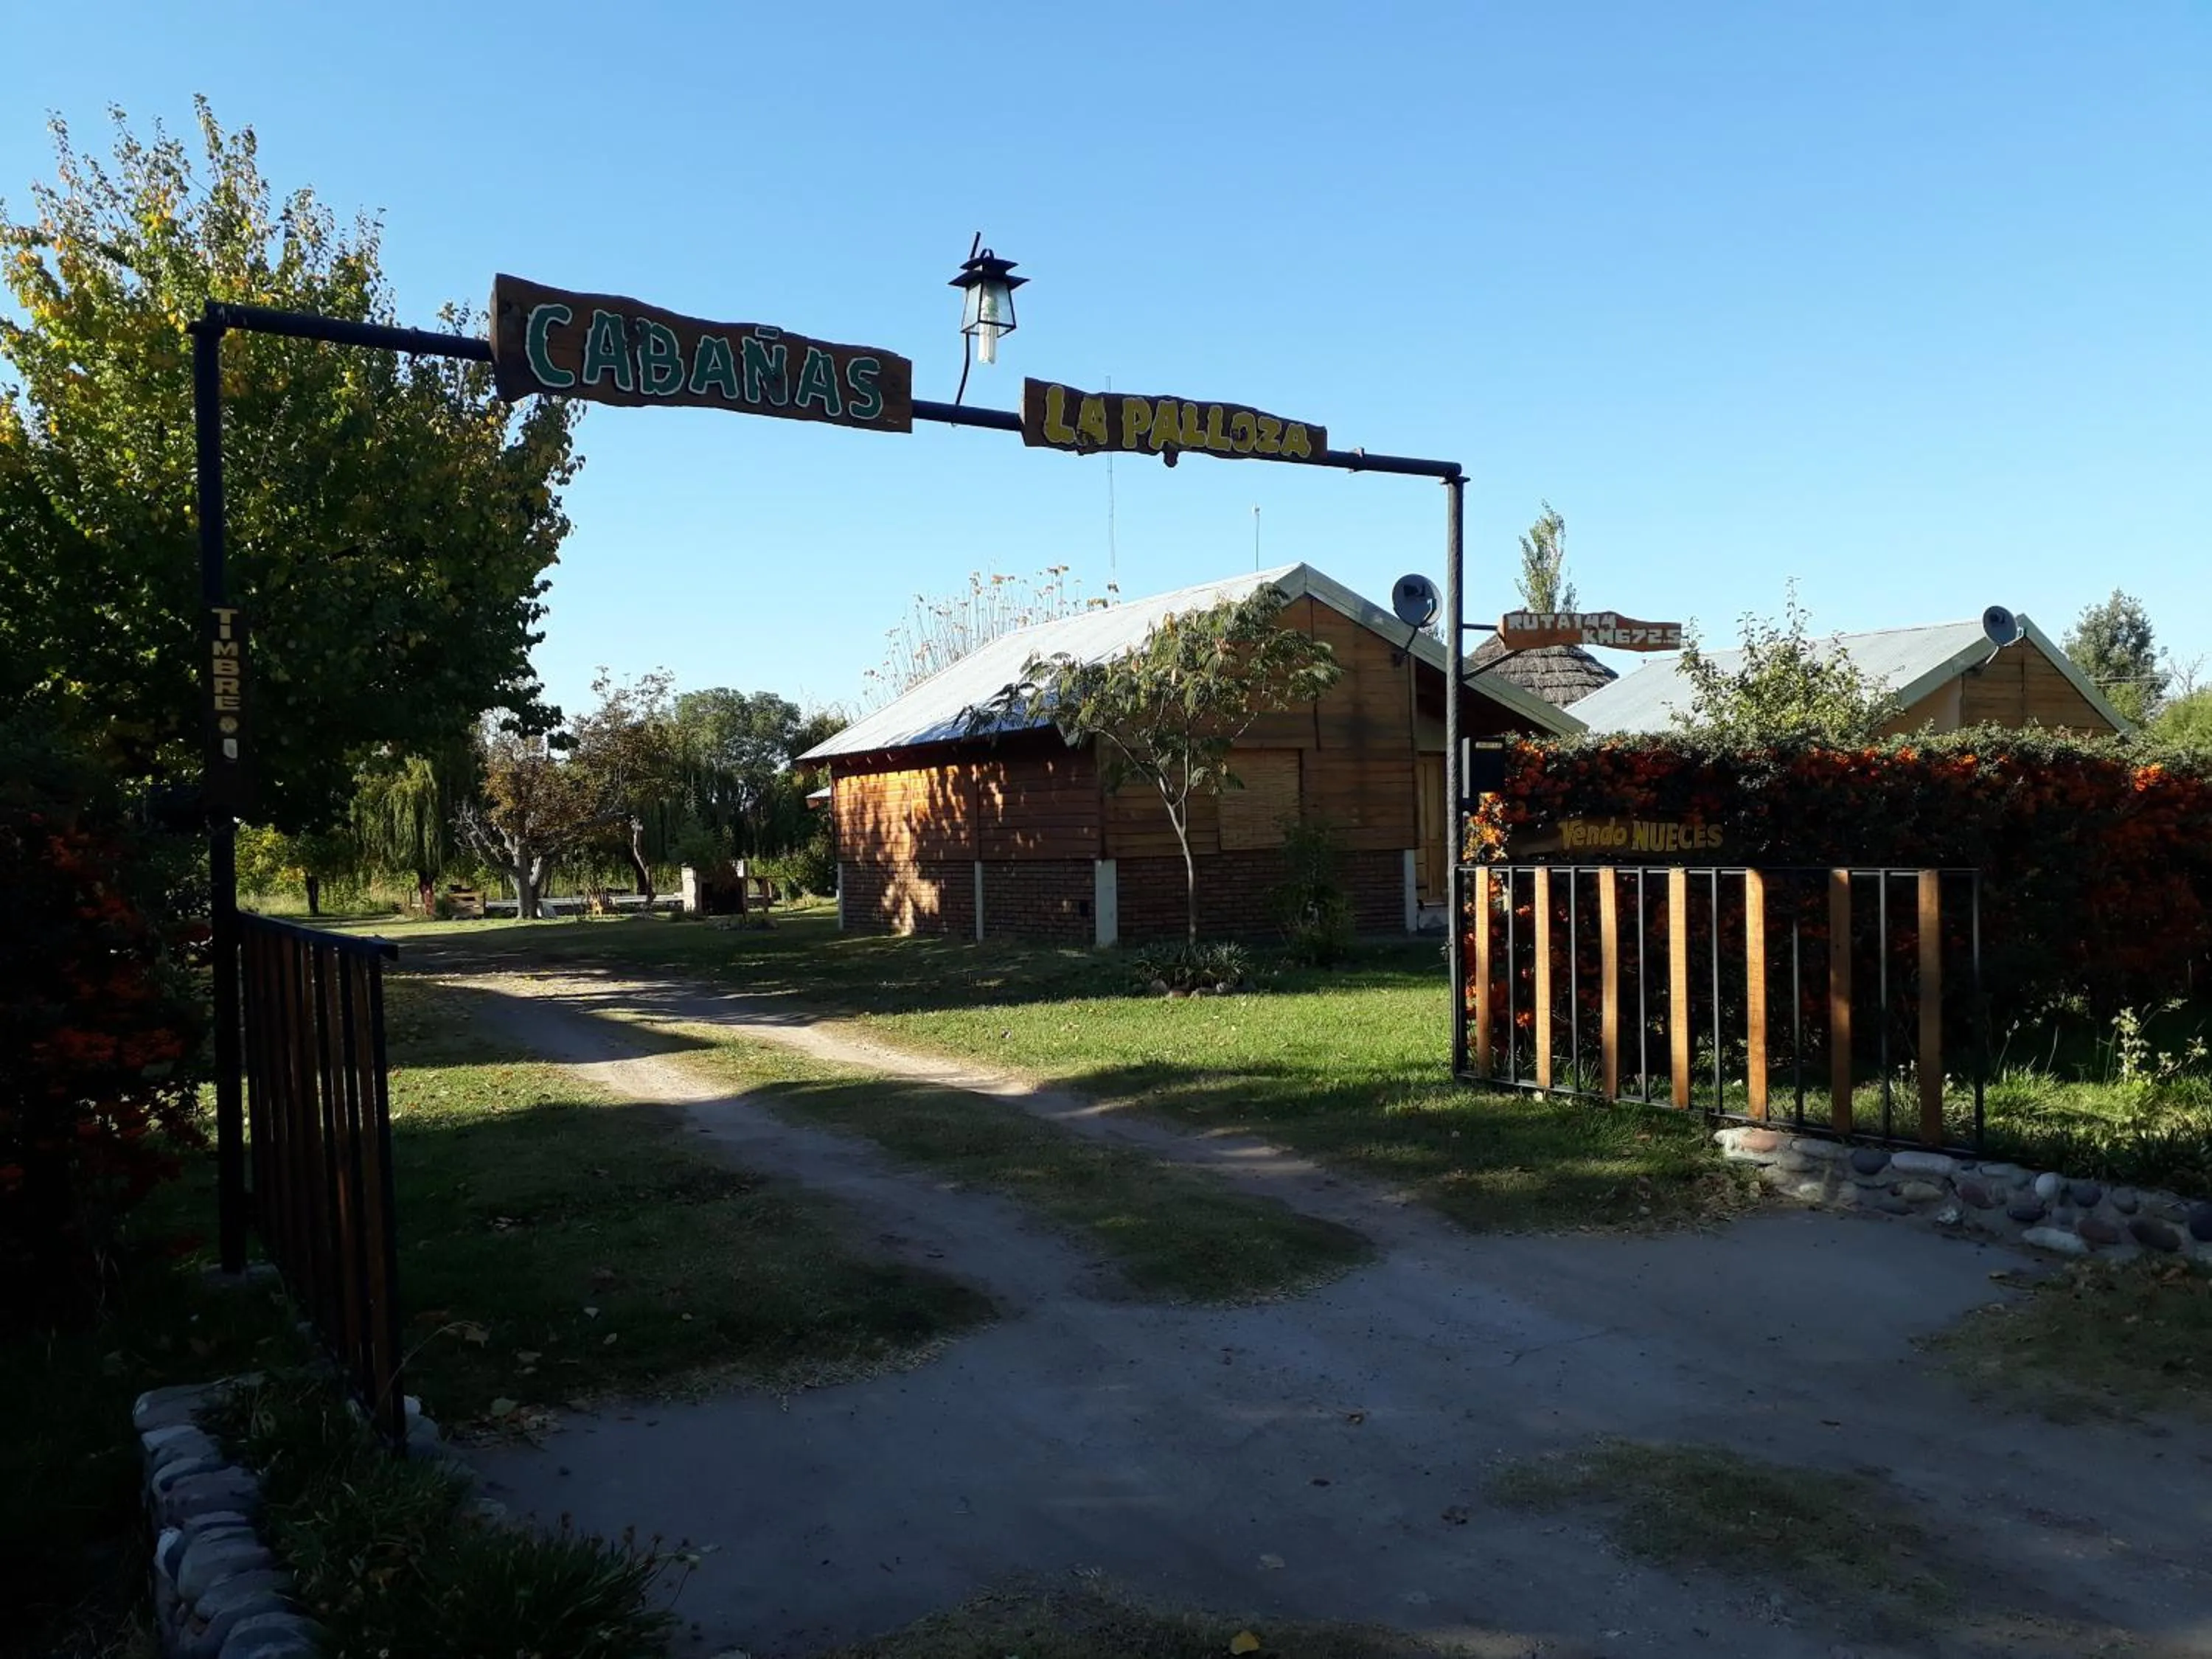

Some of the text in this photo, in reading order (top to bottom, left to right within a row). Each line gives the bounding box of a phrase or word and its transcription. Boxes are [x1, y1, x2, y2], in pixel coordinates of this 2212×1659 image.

[526, 303, 884, 420] CABAÑAS
[1043, 385, 1312, 458] LA PALLOZA
[212, 608, 240, 710] TIMBRE
[1557, 817, 1724, 852] Vendo NUECES
